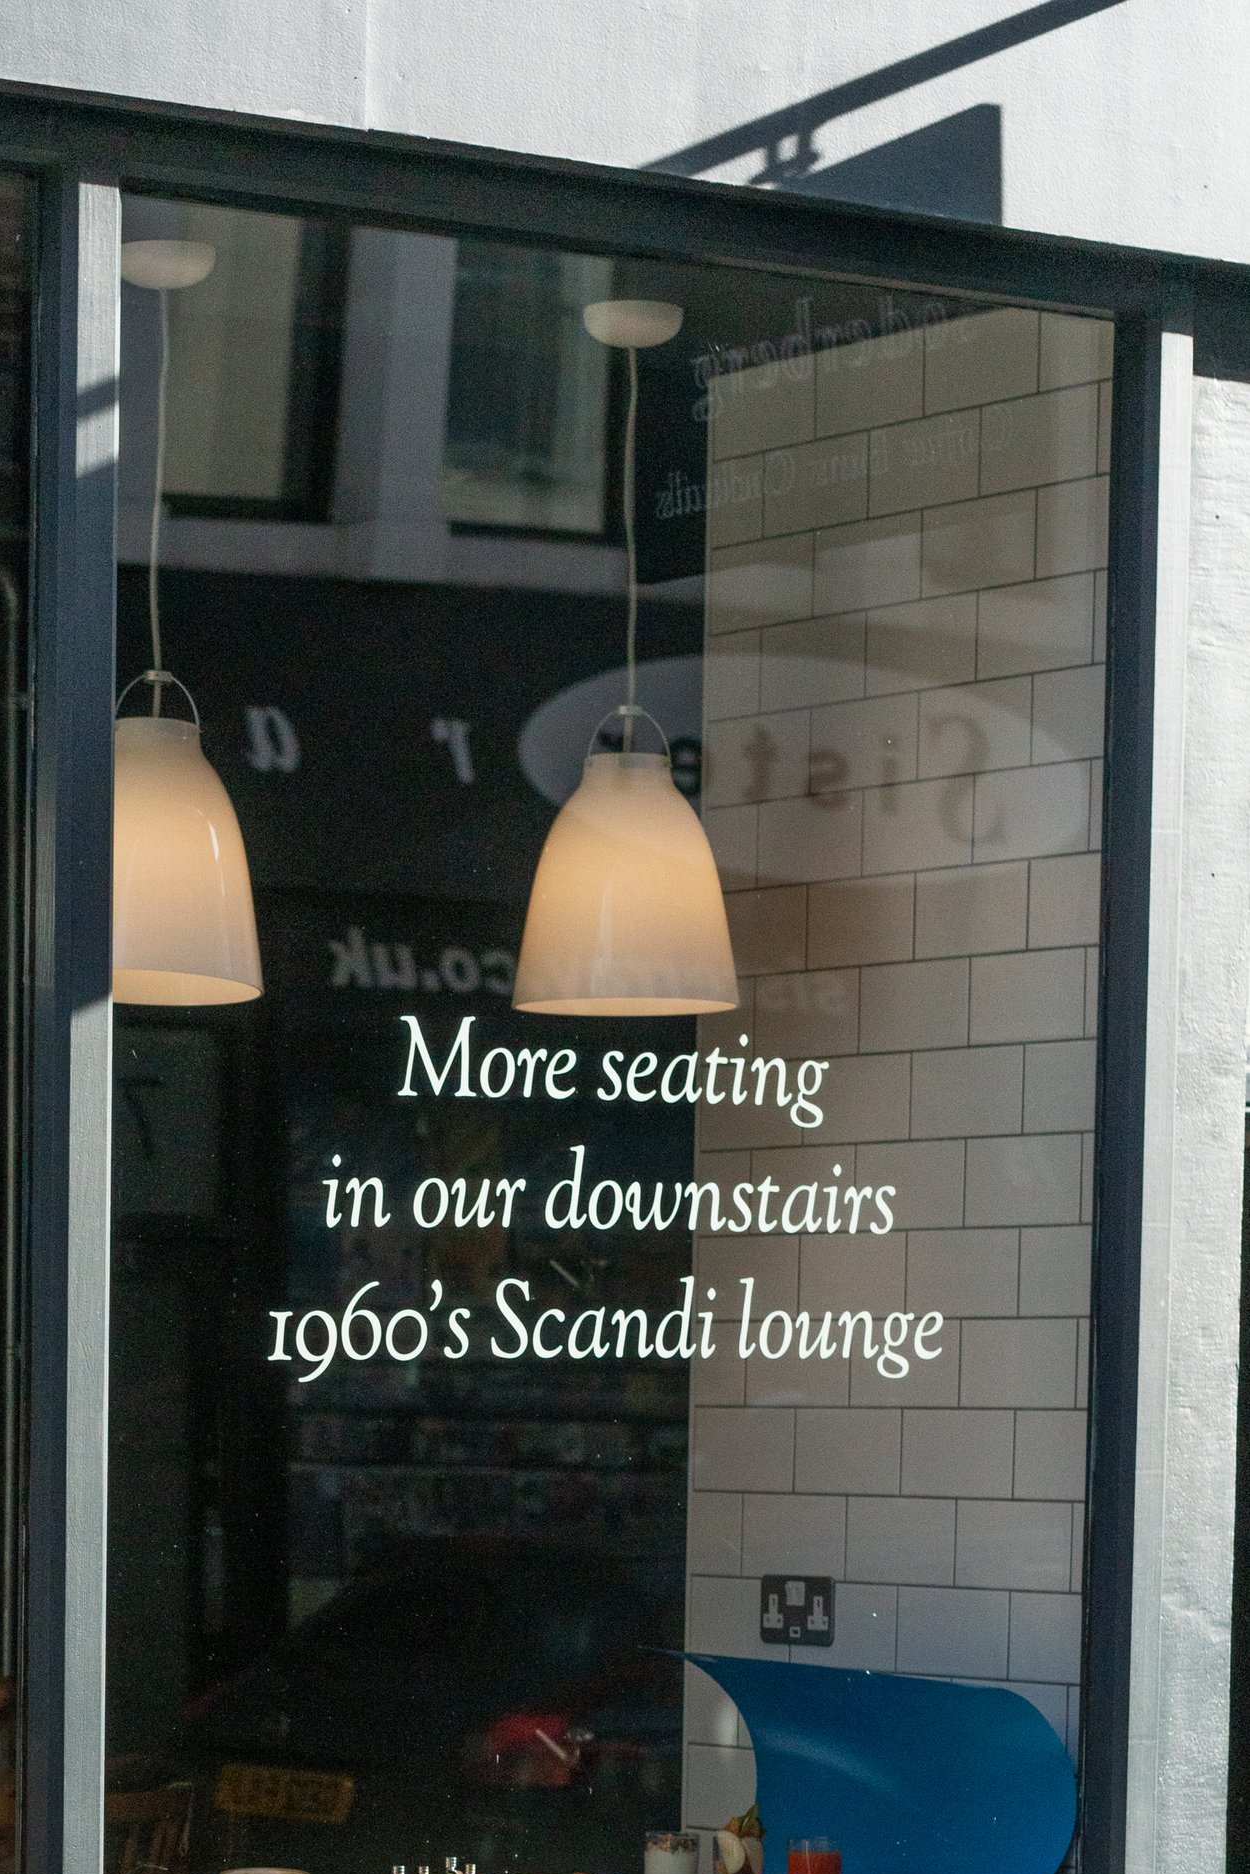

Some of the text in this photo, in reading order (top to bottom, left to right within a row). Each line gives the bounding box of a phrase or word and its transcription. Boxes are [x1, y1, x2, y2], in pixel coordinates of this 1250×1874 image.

[397, 1015, 829, 1128] More seating
[322, 1146, 896, 1235] in our downstairs
[491, 1276, 717, 1360] Scandi
[738, 1278, 944, 1379] lounge
